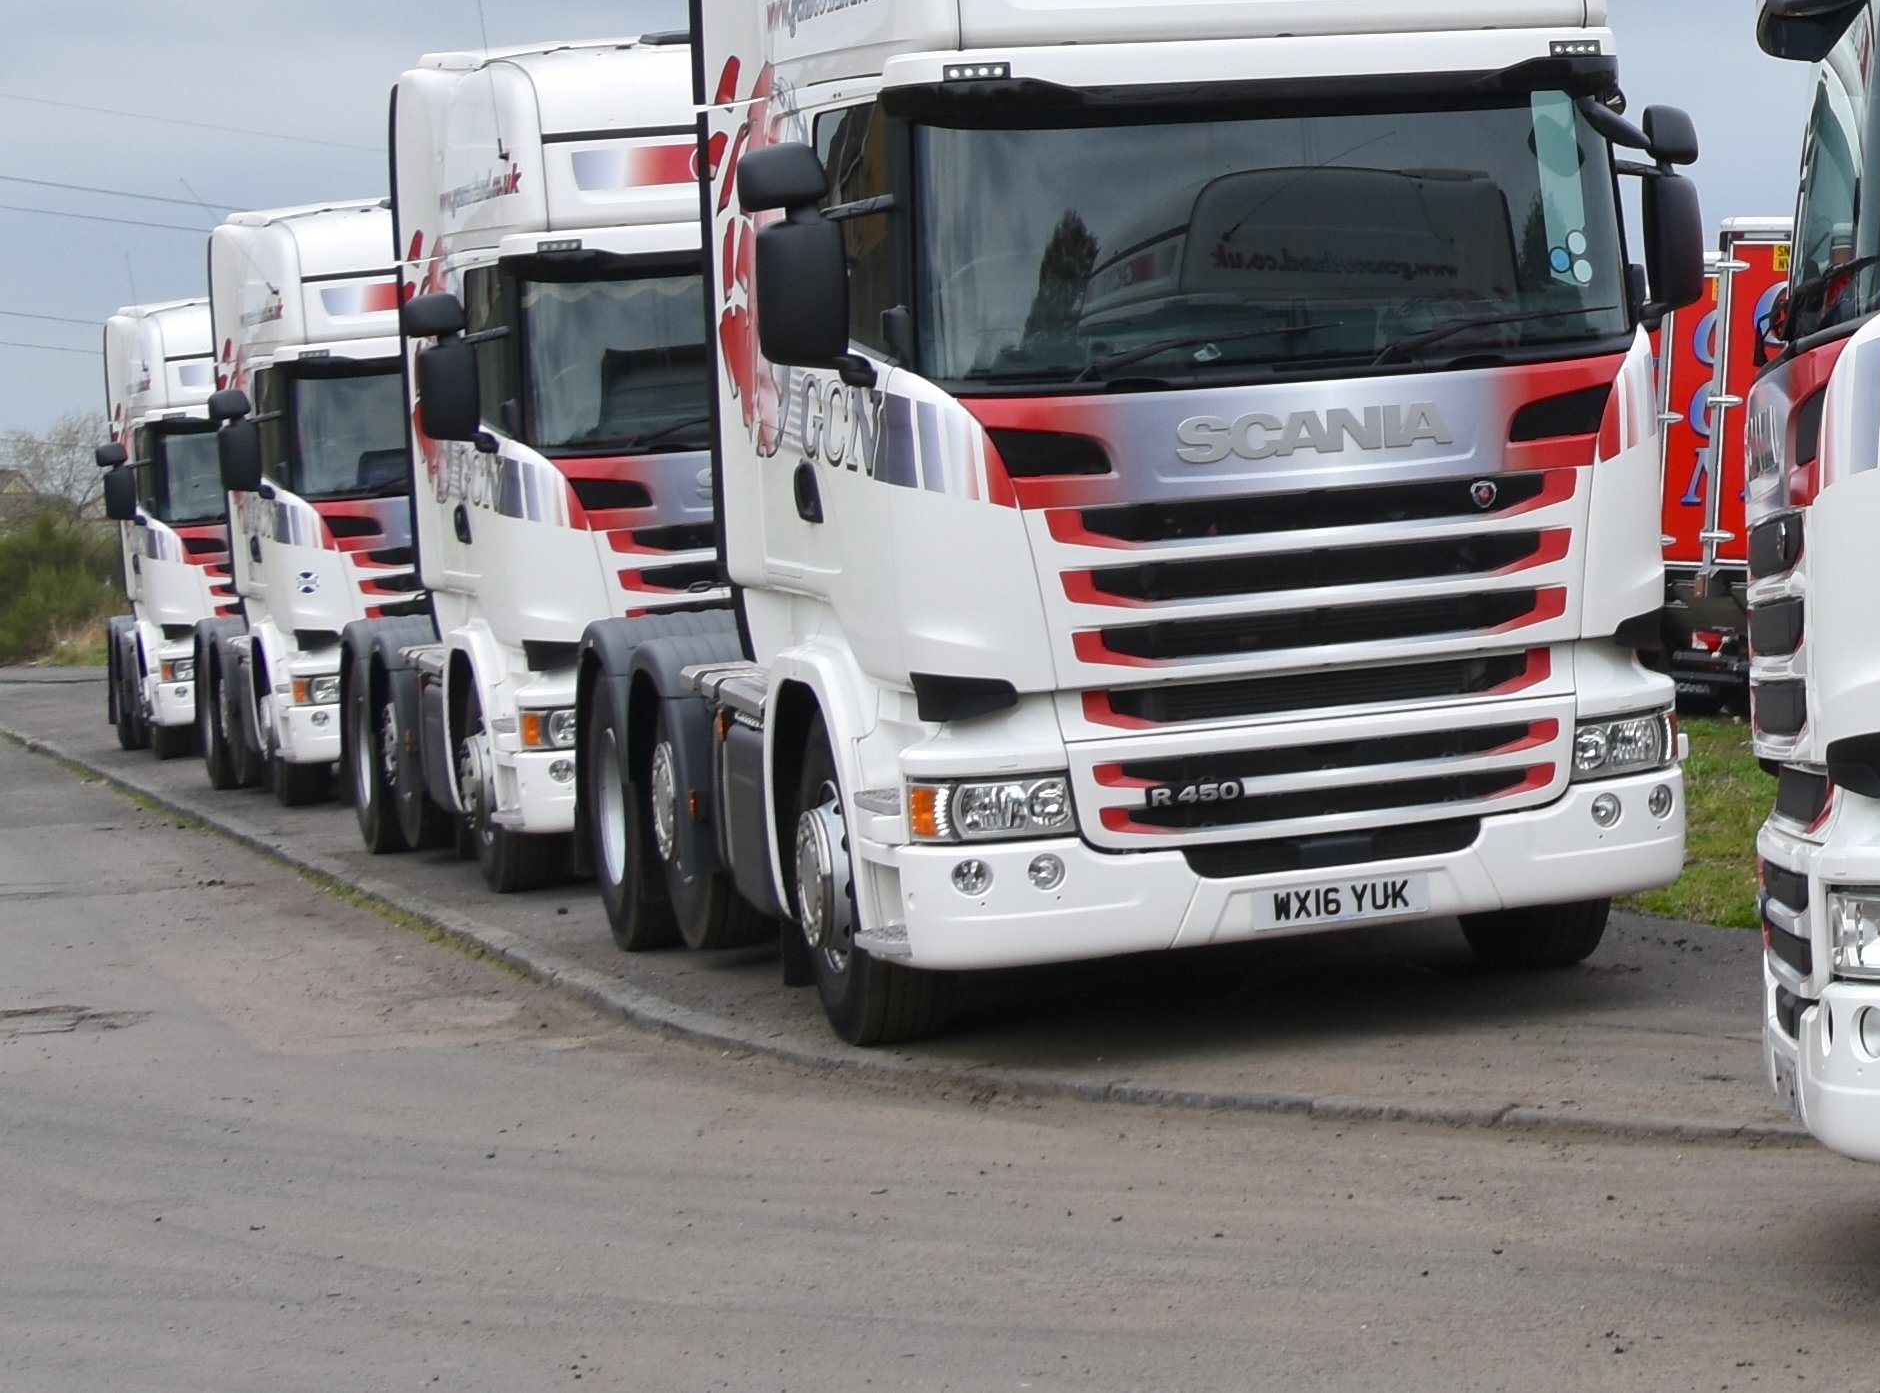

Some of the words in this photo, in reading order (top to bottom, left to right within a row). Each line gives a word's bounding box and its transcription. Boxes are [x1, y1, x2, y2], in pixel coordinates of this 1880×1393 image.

[801, 373, 884, 477] GCN
[1176, 400, 1454, 464] SCANIA
[1151, 788, 1172, 807] R
[1177, 781, 1240, 802] 450
[1273, 886, 1341, 922] WX16
[1350, 879, 1410, 912] YUK
